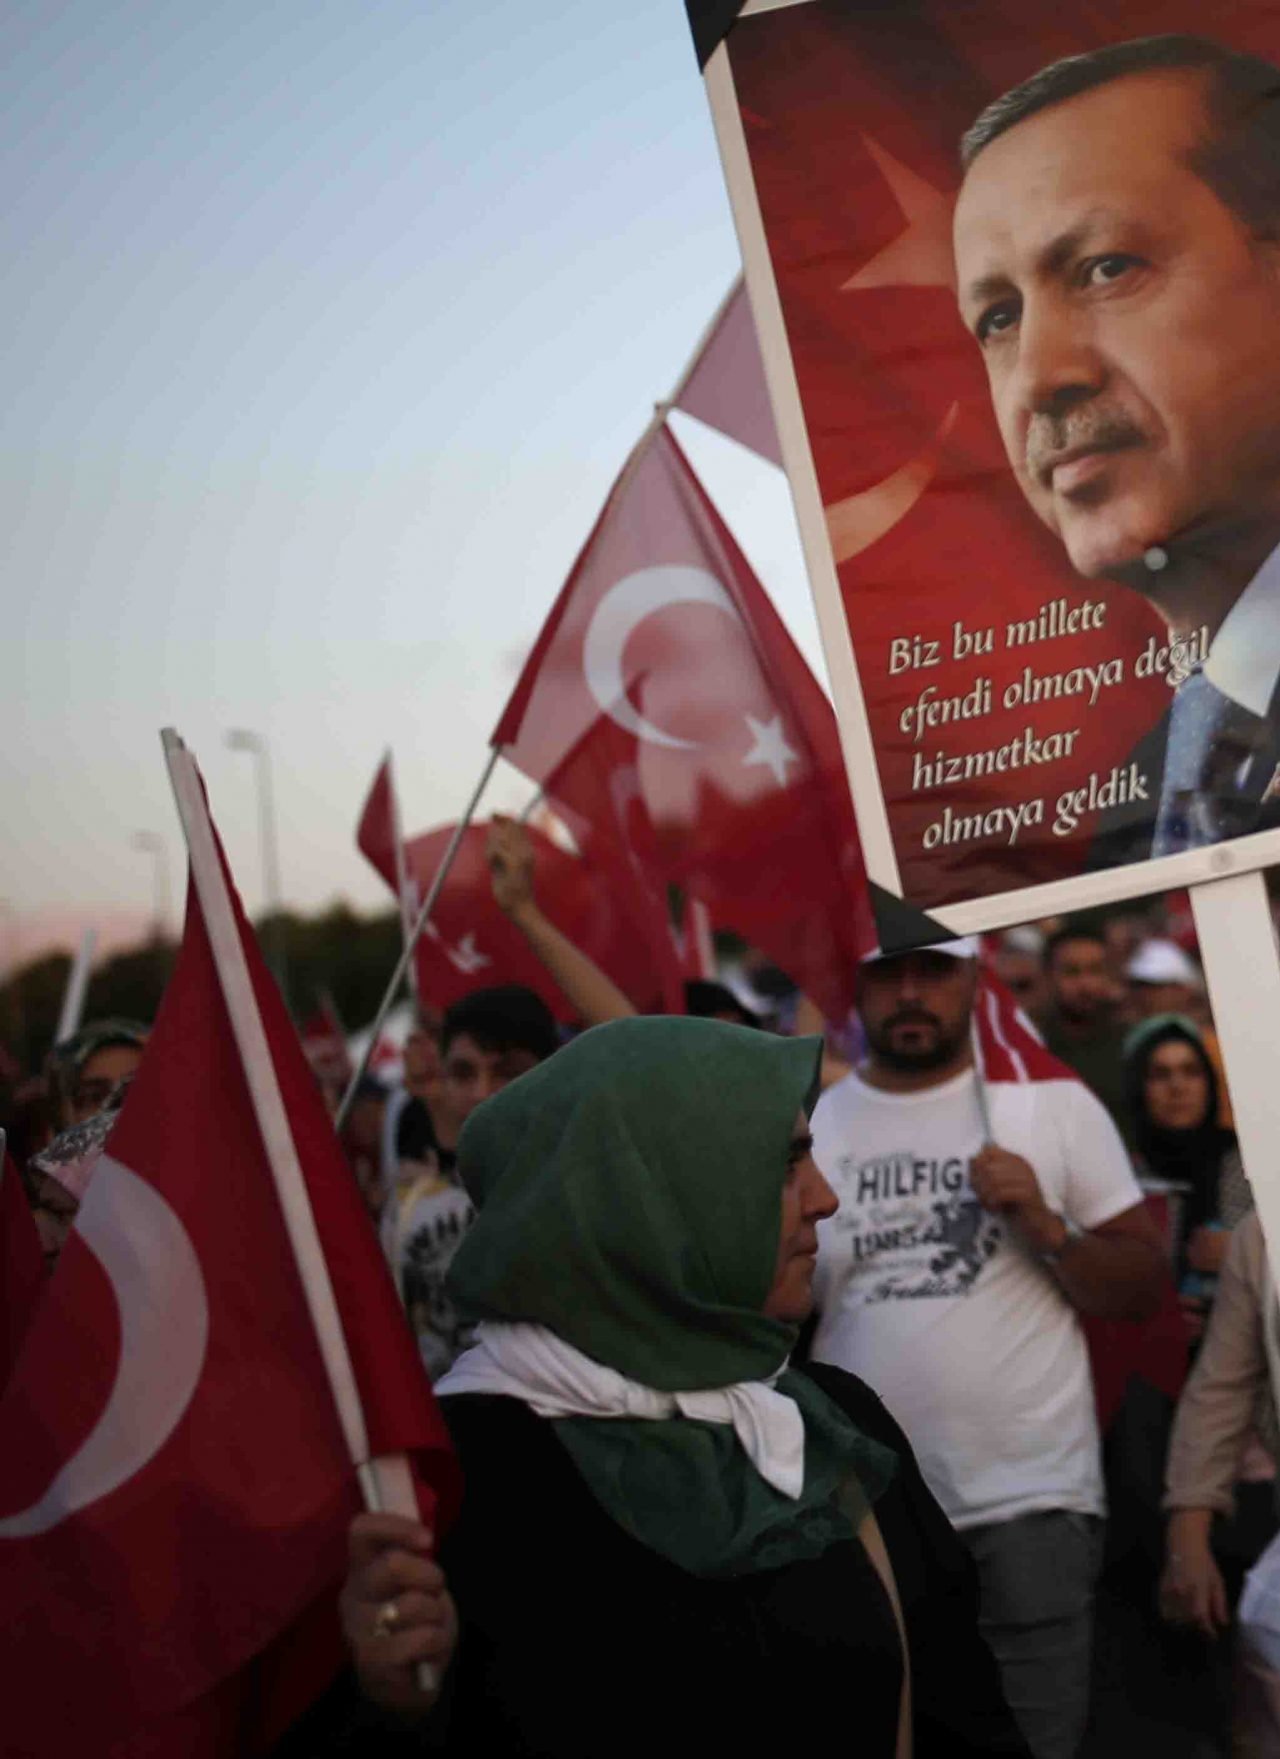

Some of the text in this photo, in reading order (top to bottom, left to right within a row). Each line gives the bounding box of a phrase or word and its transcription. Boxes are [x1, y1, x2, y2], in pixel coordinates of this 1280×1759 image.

[888, 598, 1107, 675] Biz bu millete
[899, 625, 1210, 742] efendi olmaya değil
[912, 726, 1081, 790] hizmetkar
[922, 763, 1149, 850] olmaya geldik
[856, 1158, 964, 1204] HILFIG
